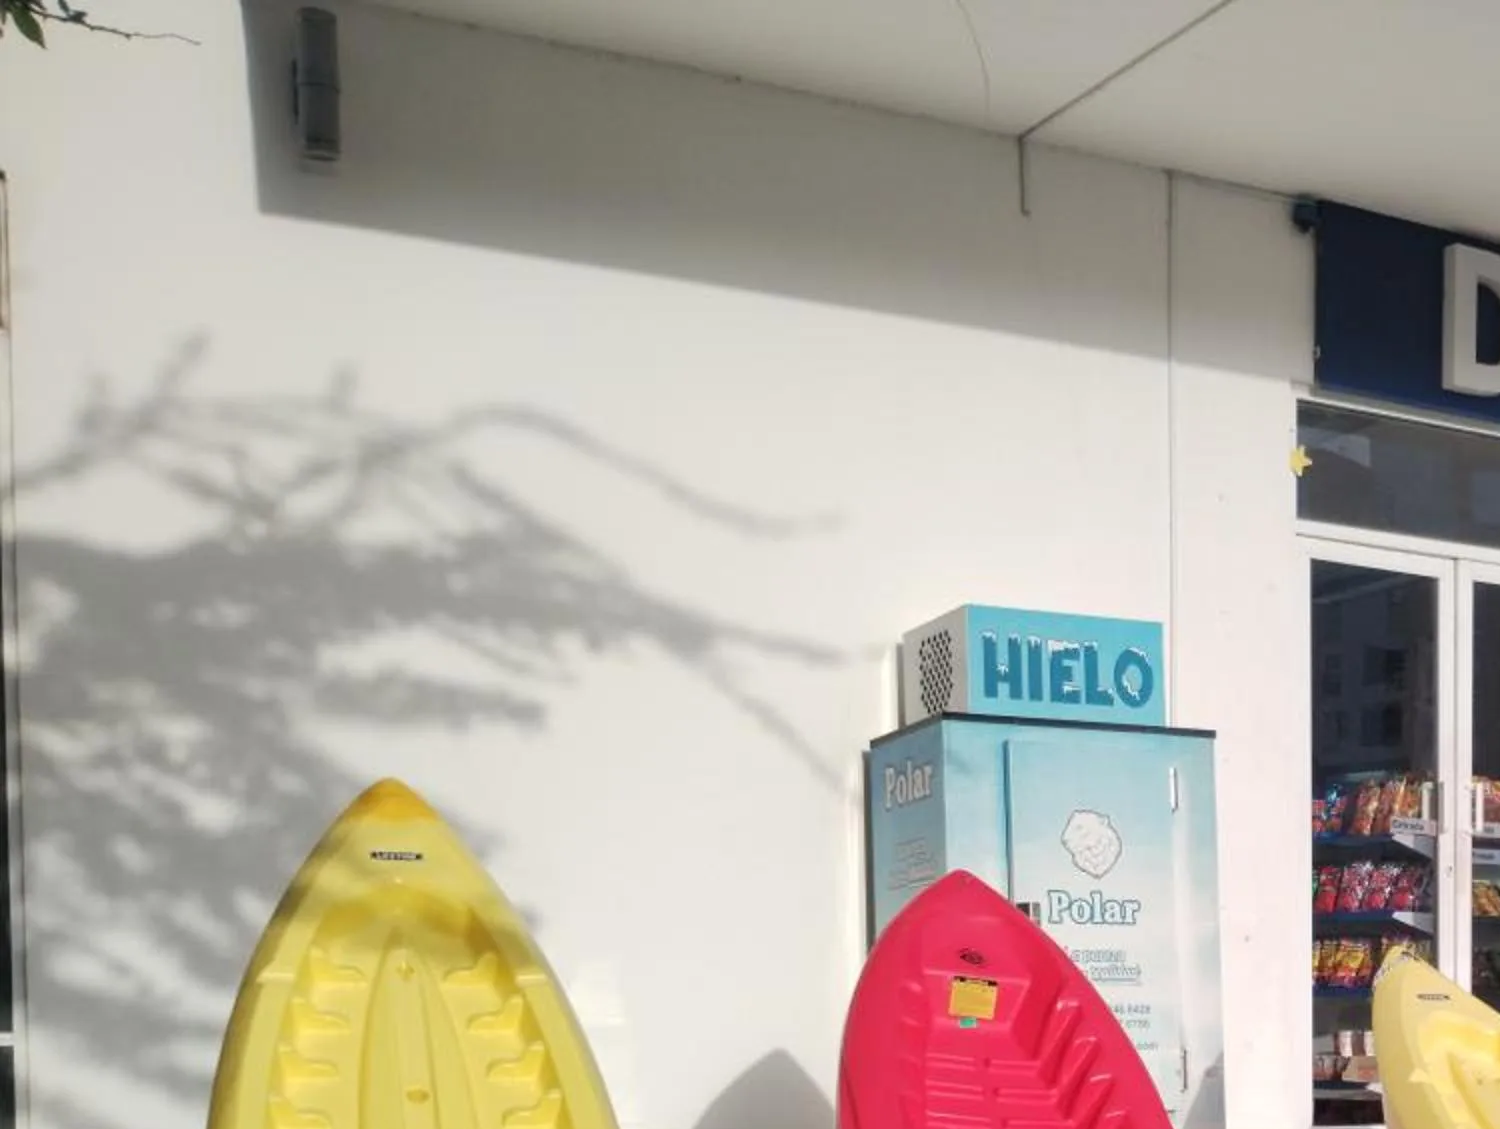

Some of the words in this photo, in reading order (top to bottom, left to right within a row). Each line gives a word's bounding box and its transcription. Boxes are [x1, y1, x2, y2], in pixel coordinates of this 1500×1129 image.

[981, 631, 1154, 708] HIELO
[884, 758, 933, 812] Polar
[1047, 888, 1141, 924] Polar
